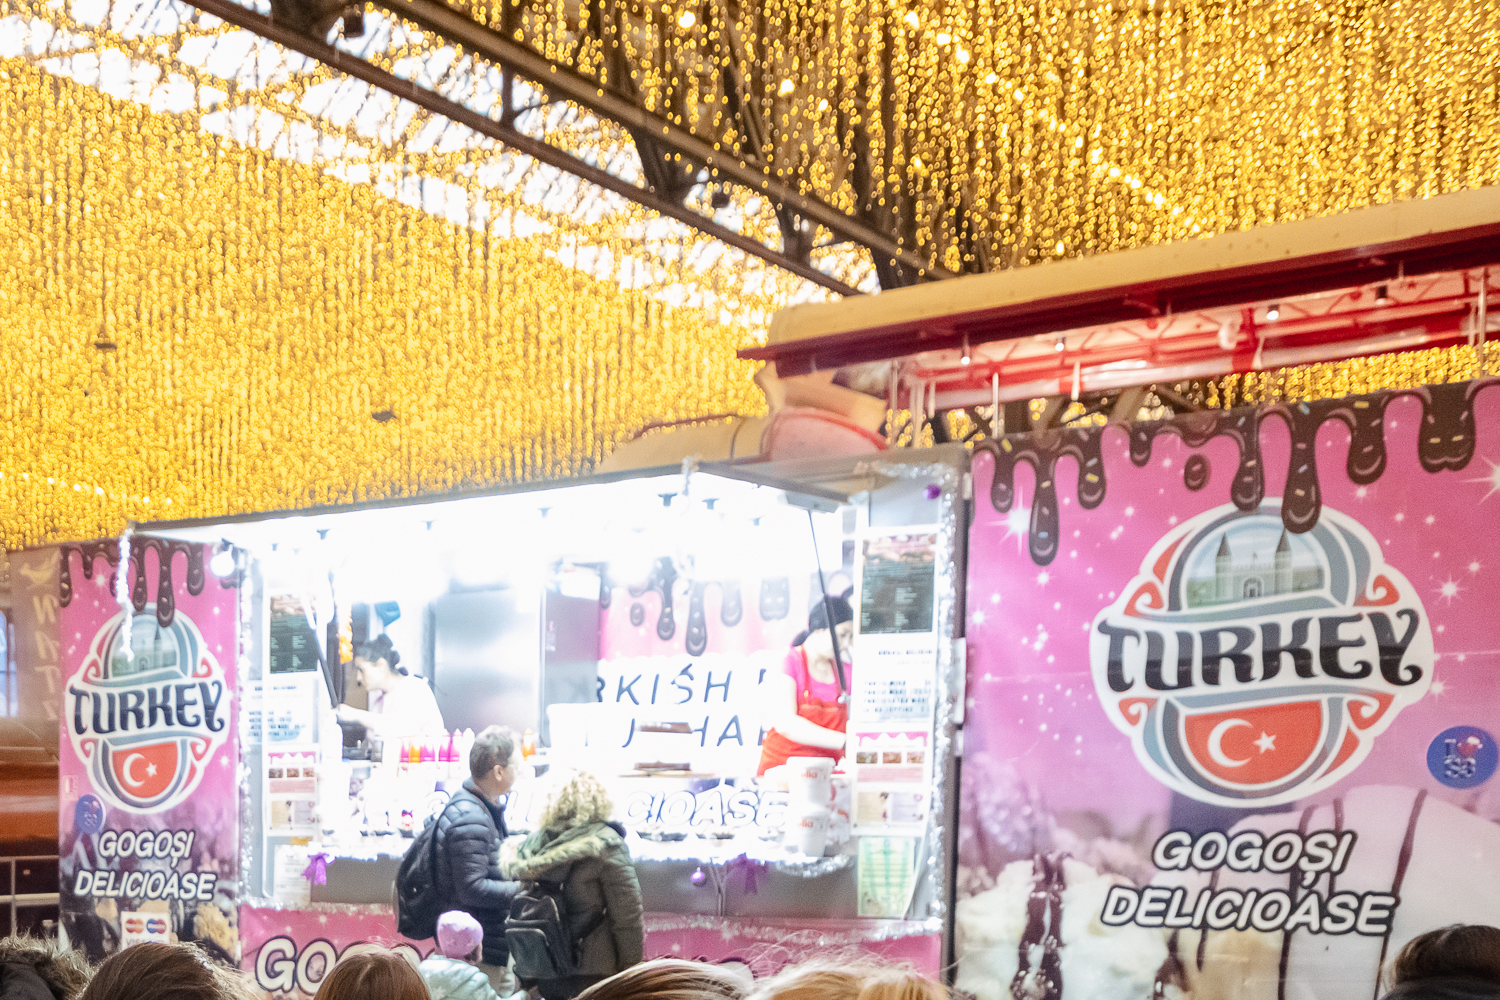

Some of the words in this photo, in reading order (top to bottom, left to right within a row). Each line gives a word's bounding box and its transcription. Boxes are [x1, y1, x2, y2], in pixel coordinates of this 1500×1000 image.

[1097, 608, 1424, 693] TURKEY
[69, 680, 225, 735] TURKEY
[597, 664, 732, 705] RKISH
[99, 830, 196, 868] GOGOȘI
[1154, 832, 1356, 887] GOGOȘI
[73, 869, 217, 901] DELICIOASE
[1101, 886, 1396, 935] DELICIOASE
